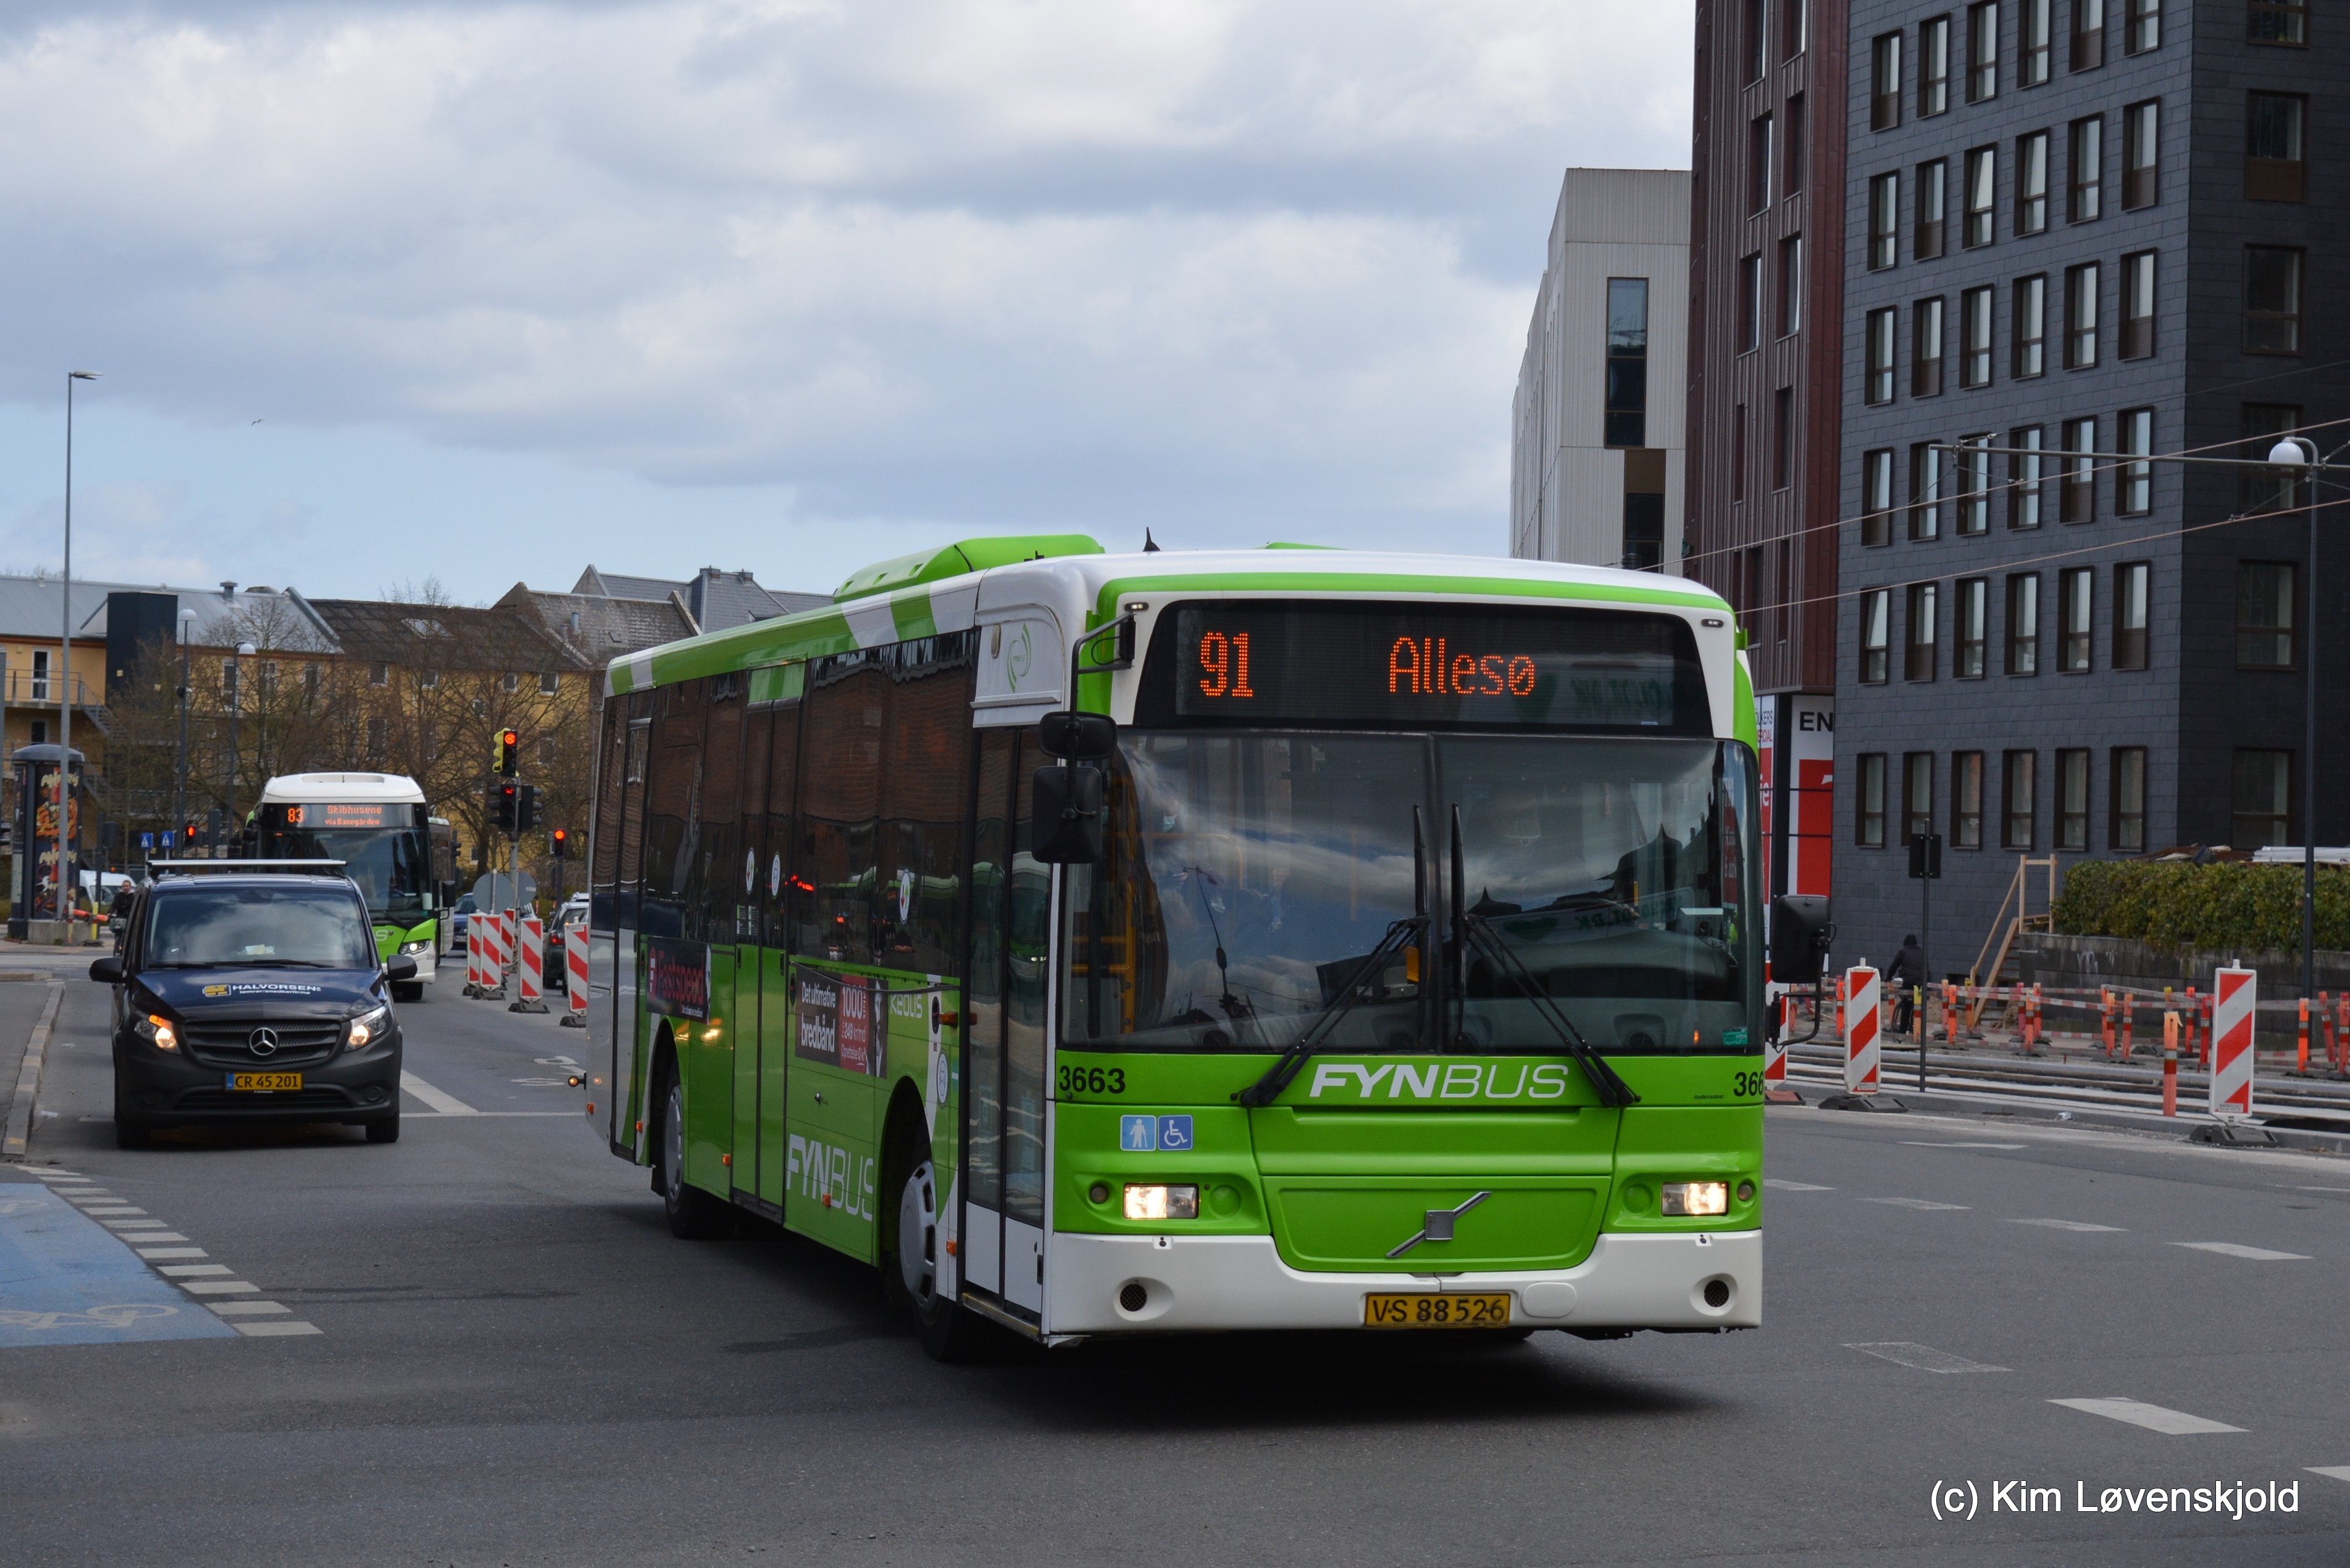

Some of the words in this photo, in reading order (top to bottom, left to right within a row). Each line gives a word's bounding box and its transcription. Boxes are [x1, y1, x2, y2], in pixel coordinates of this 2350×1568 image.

[1200, 631, 1254, 698] 91
[1389, 636, 1536, 696] Allesø
[287, 808, 304, 823] 83
[327, 805, 382, 815] Skibhusene
[801, 981, 811, 1004] Det
[811, 982, 836, 1009] ultimative
[842, 985, 863, 1019] 1000
[801, 1012, 835, 1053] bredbånd
[235, 1075, 253, 1088] CR
[256, 1075, 272, 1088] 45
[275, 1075, 298, 1088] 201
[1059, 1065, 1126, 1094] 3663
[1309, 1064, 1569, 1098] FYNBUS
[786, 1133, 874, 1222] FYNBUS
[1373, 1299, 1408, 1322] VS
[1417, 1299, 1449, 1322] 88
[1455, 1299, 1505, 1322] 526
